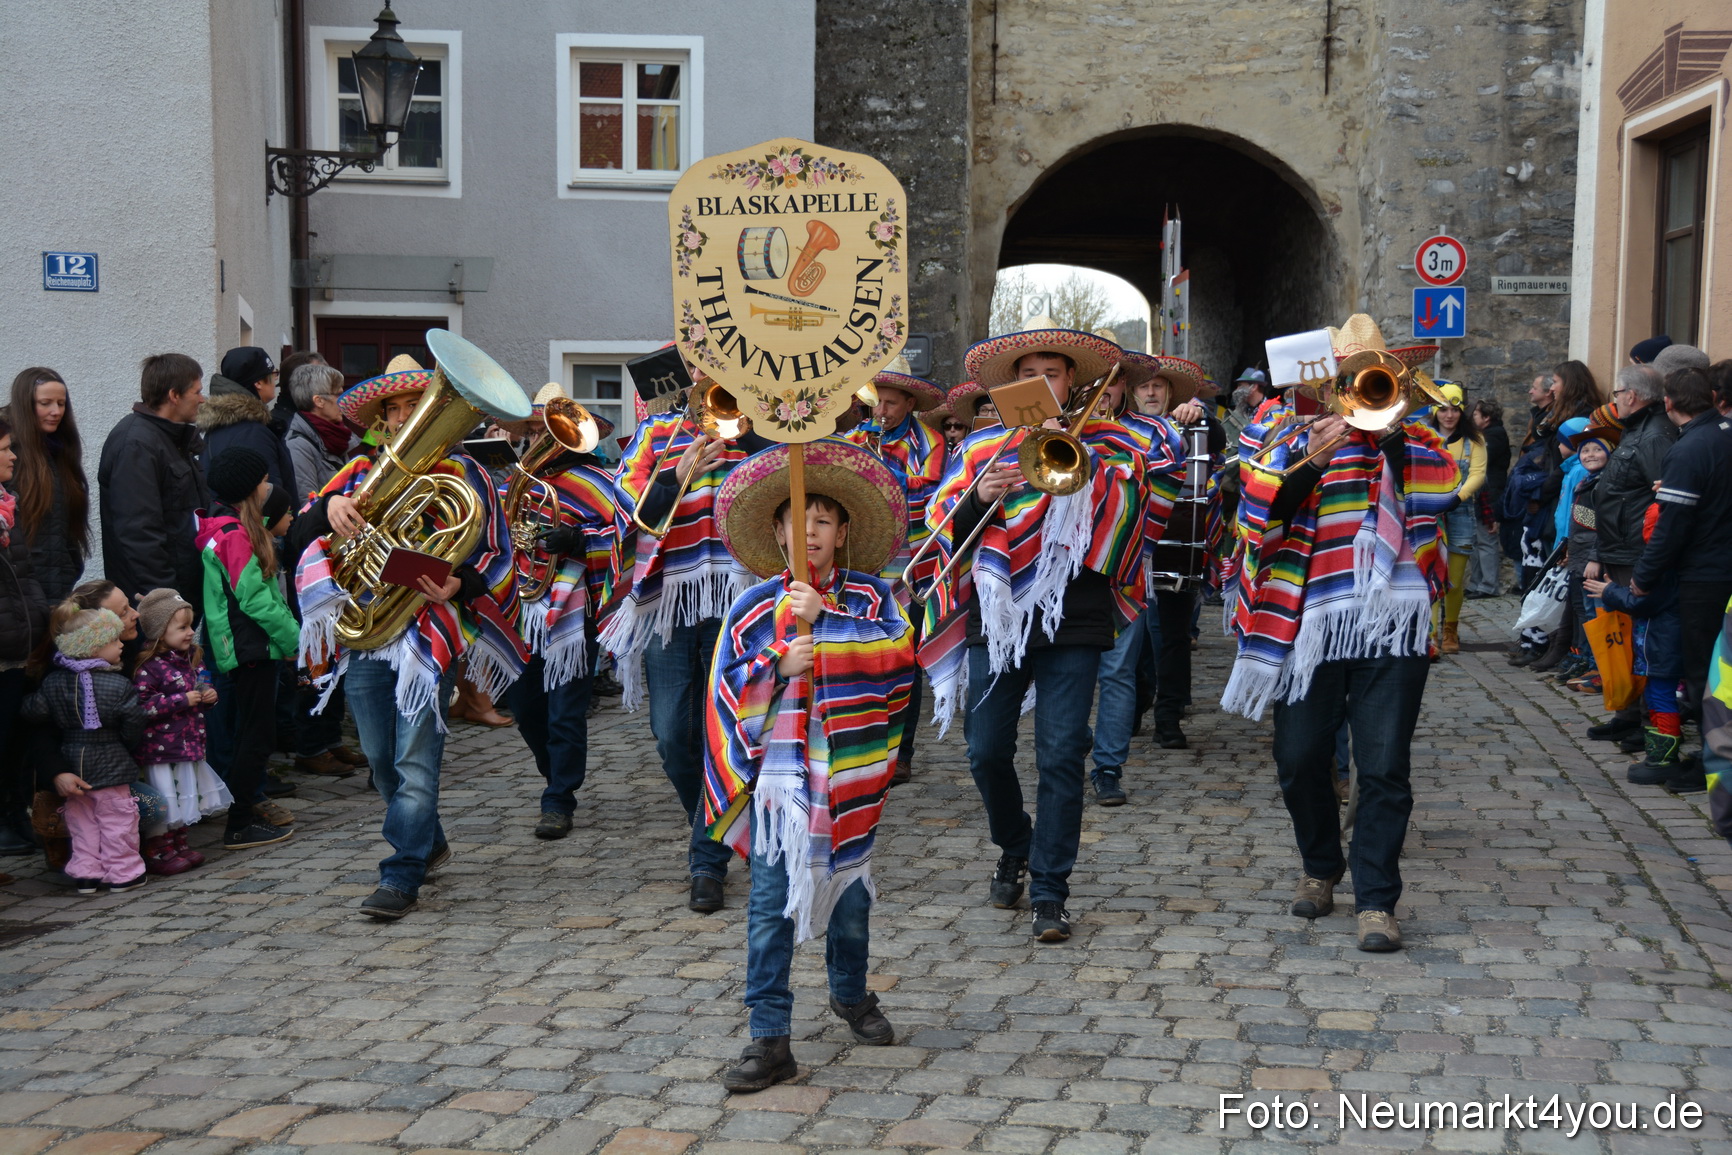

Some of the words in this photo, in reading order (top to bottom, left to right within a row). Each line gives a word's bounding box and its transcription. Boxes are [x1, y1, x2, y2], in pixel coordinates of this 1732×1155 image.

[696, 192, 879, 217] BLASKAPELLE
[55, 255, 87, 275] 12
[48, 276, 93, 288] Reichenauplatz
[1497, 279, 1568, 292] Ringmauerweg
[695, 256, 884, 383] THANNHAUSEN
